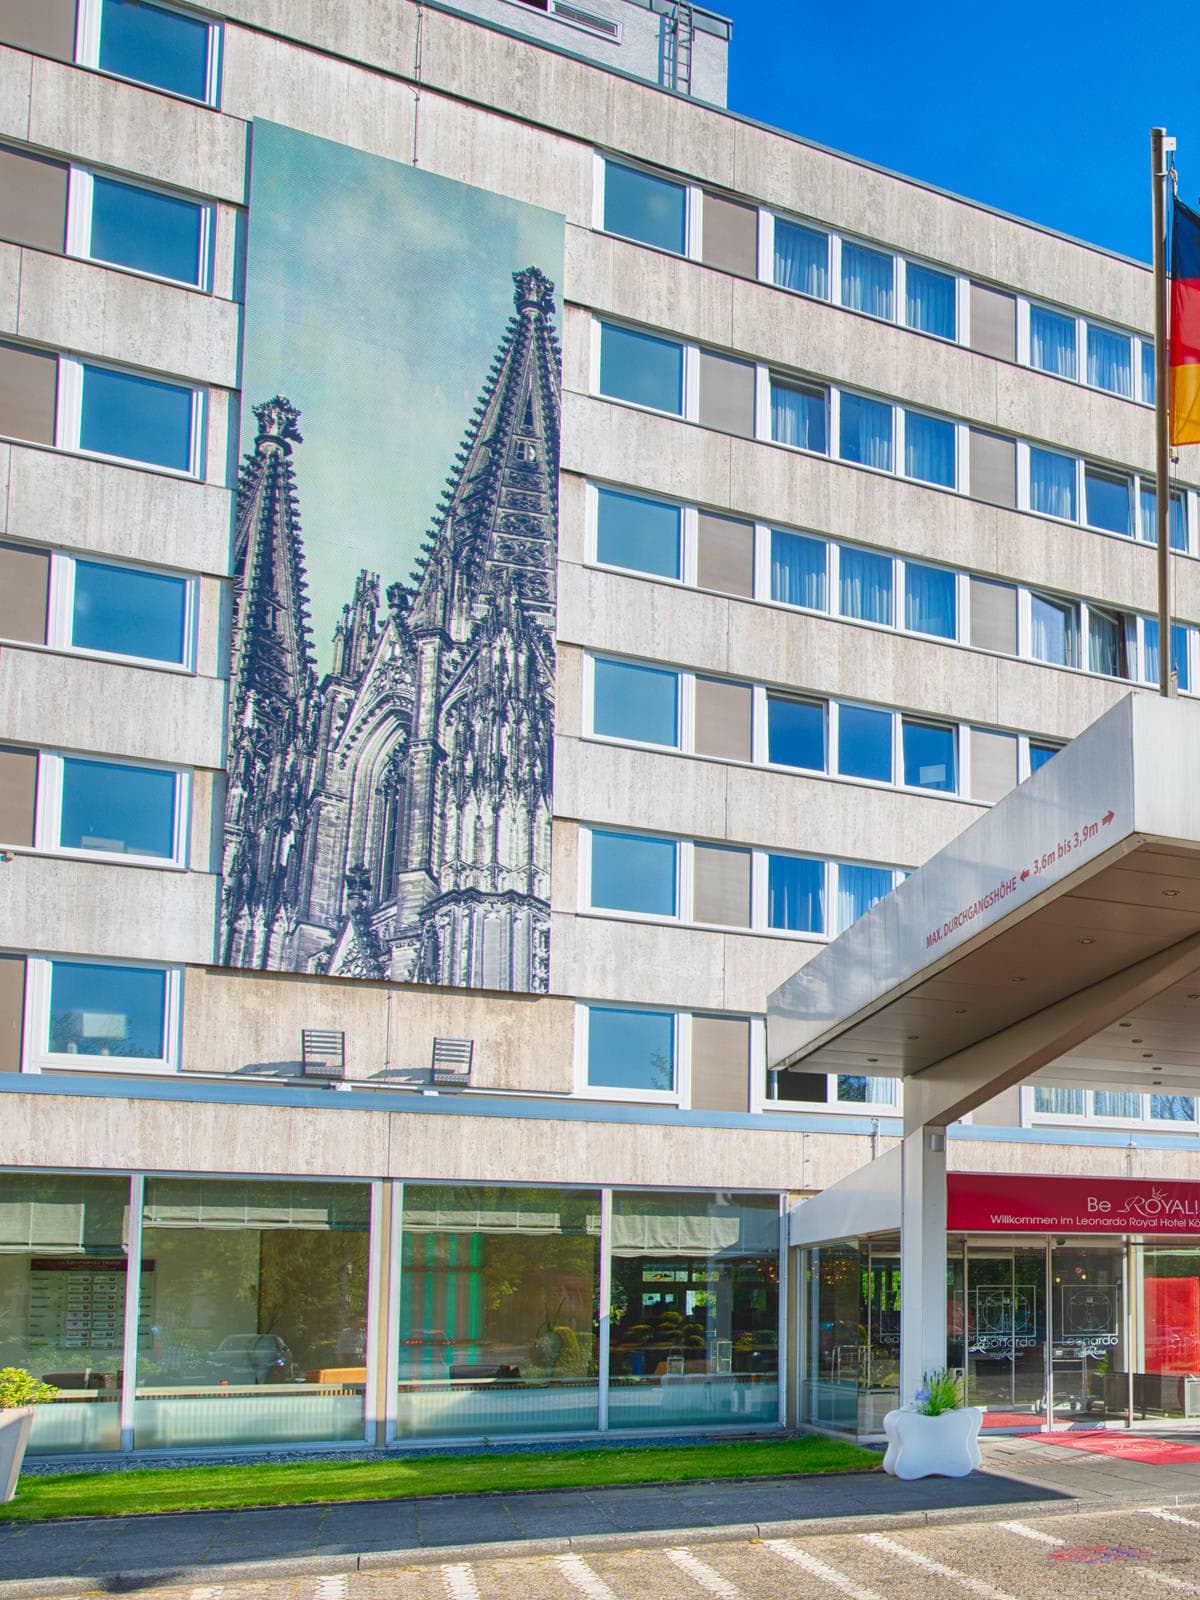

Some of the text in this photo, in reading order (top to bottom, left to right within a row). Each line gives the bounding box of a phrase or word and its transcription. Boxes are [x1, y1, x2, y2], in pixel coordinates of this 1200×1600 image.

[926, 821, 1099, 949] MAX. DURCHGANGSHÖHE 3,6m bis 3,9m
[1087, 1193, 1199, 1217] Be ROYAL!
[990, 1215, 1057, 1225] Willkommen
[1060, 1215, 1073, 1225] im
[1076, 1216, 1127, 1226] Leonardo
[1129, 1217, 1157, 1230] Royal
[1160, 1218, 1186, 1227] Hotel
